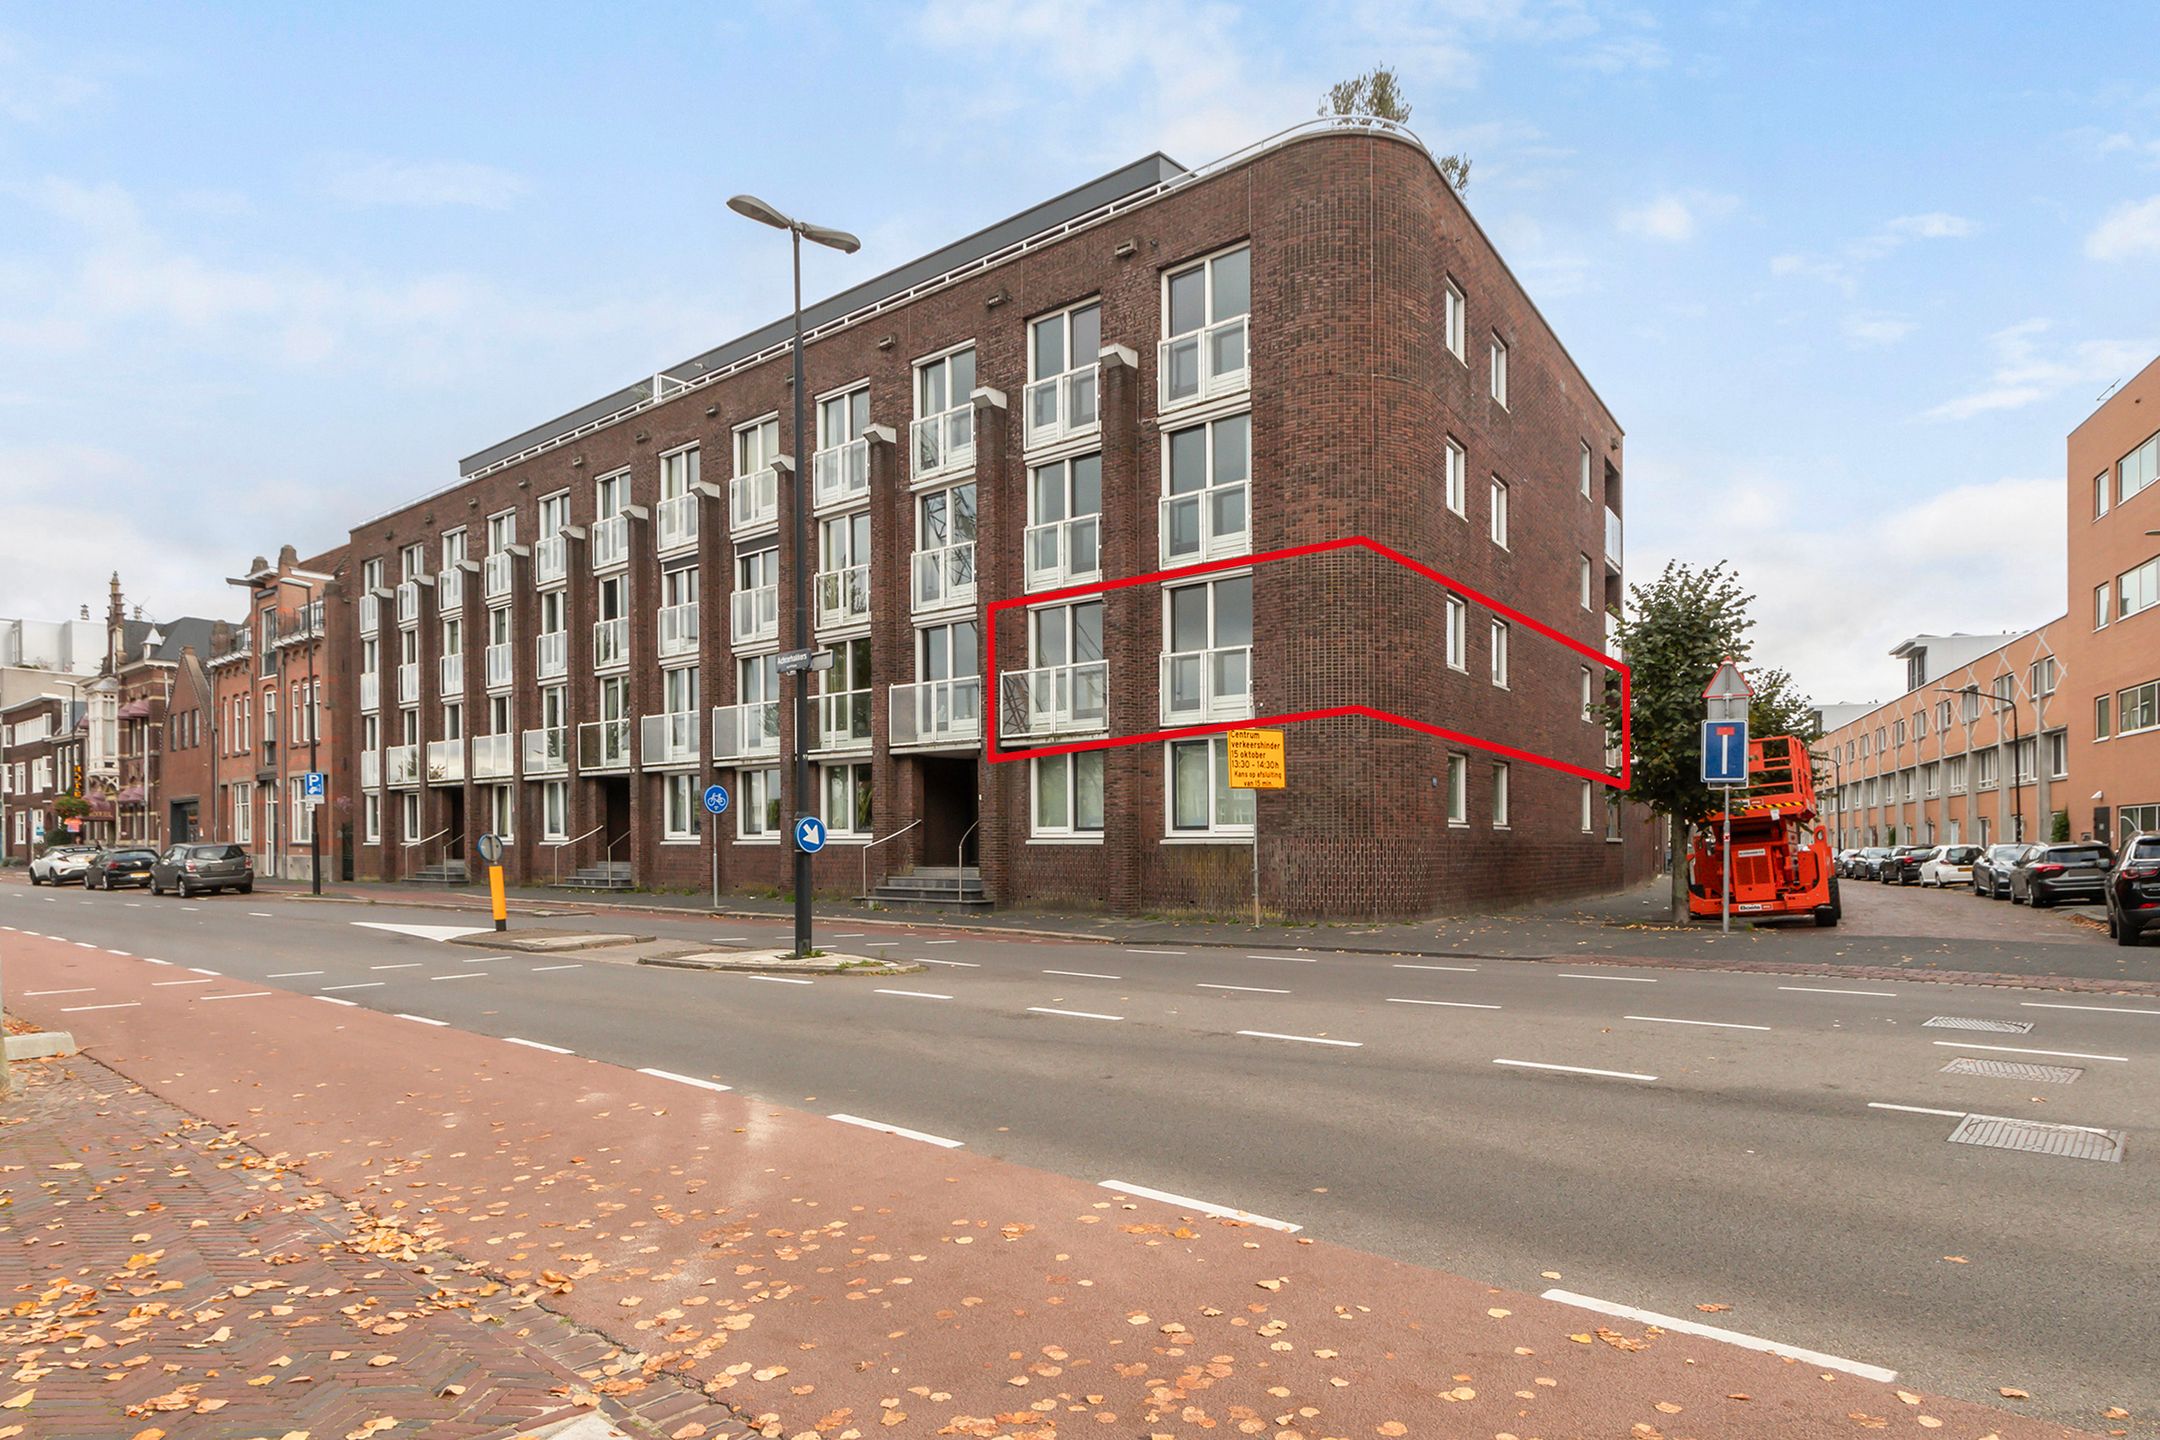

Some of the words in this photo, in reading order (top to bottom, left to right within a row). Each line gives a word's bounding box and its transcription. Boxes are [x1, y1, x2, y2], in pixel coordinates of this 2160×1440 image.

[1231, 730, 1260, 738] Centrum
[1231, 741, 1280, 749] verkeershinder
[1231, 750, 1238, 758] 15
[1240, 751, 1266, 759] oktober
[1231, 760, 1250, 768] 13:30
[309, 775, 319, 786] P
